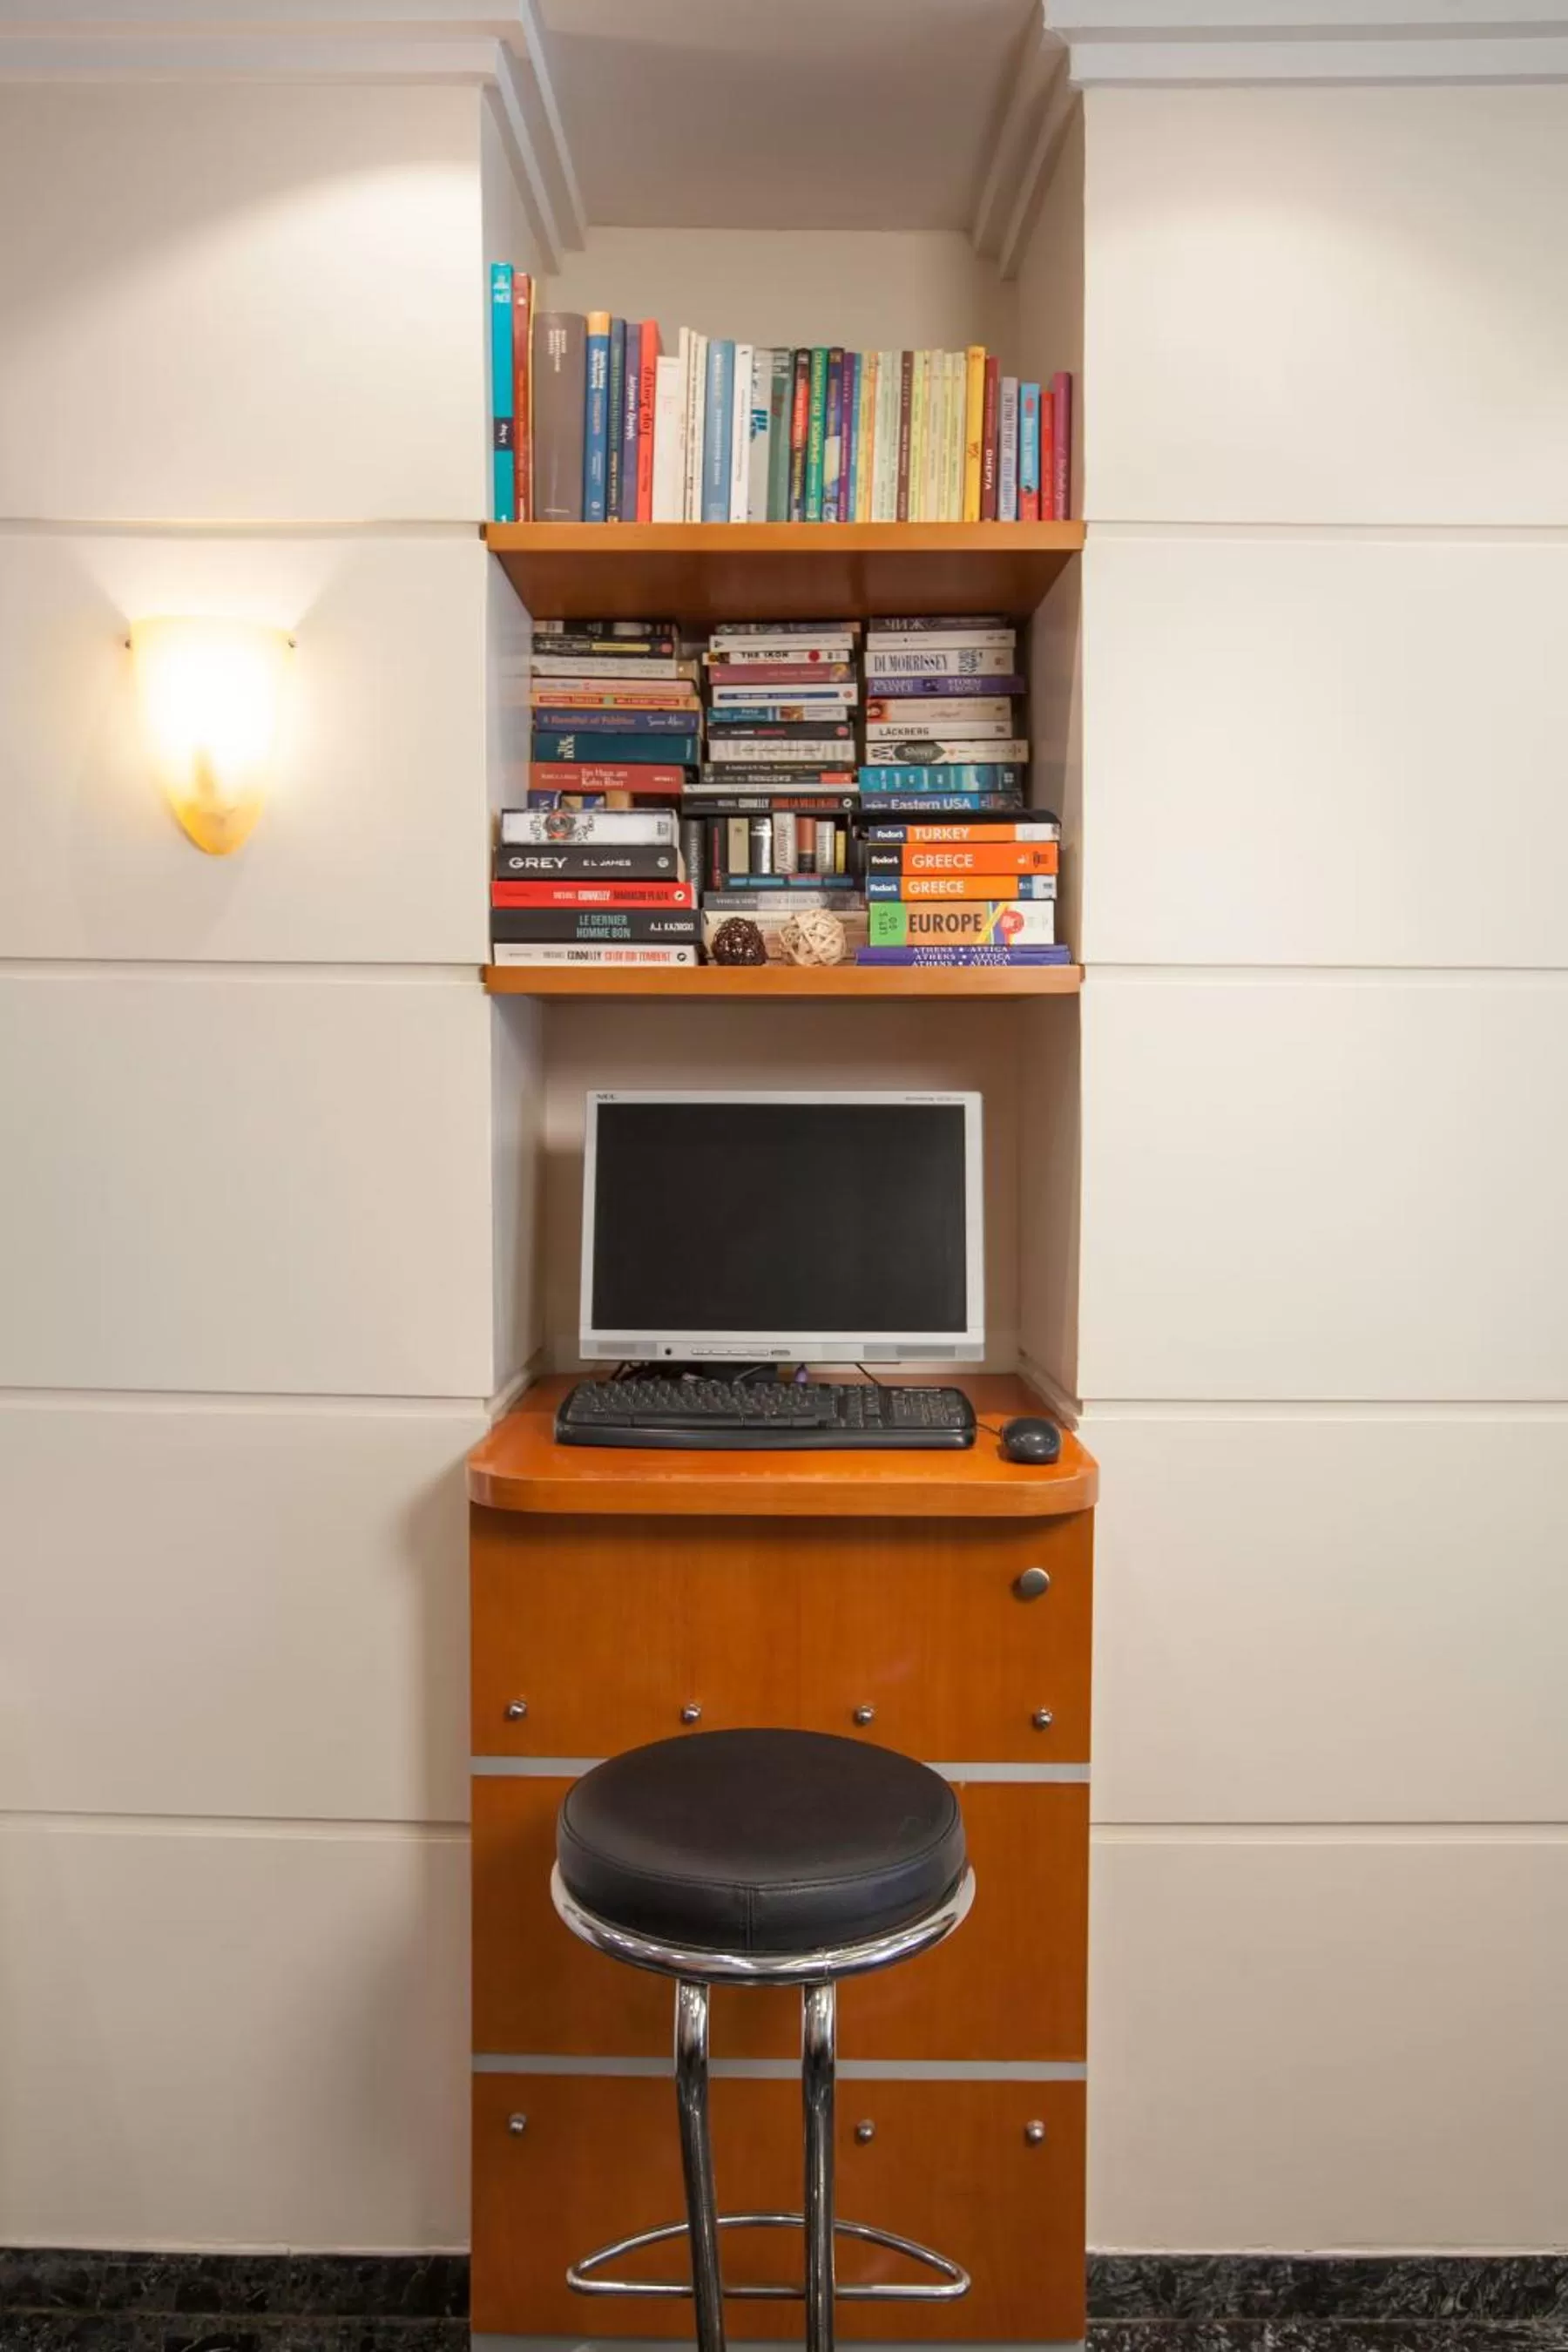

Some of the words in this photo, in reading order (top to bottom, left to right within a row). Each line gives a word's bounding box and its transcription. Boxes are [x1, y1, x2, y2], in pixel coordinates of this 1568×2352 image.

[890, 799, 941, 810] Eastern
[943, 798, 971, 809] USA
[914, 827, 970, 840] TURKEY
[508, 856, 568, 869] GREY
[911, 854, 974, 868] GREECE
[908, 881, 965, 894] GREECE
[578, 916, 589, 925] LE
[591, 915, 628, 925] DERNIER
[909, 913, 983, 934] EUROPE
[577, 928, 611, 939] HOMME
[612, 928, 632, 939] BON
